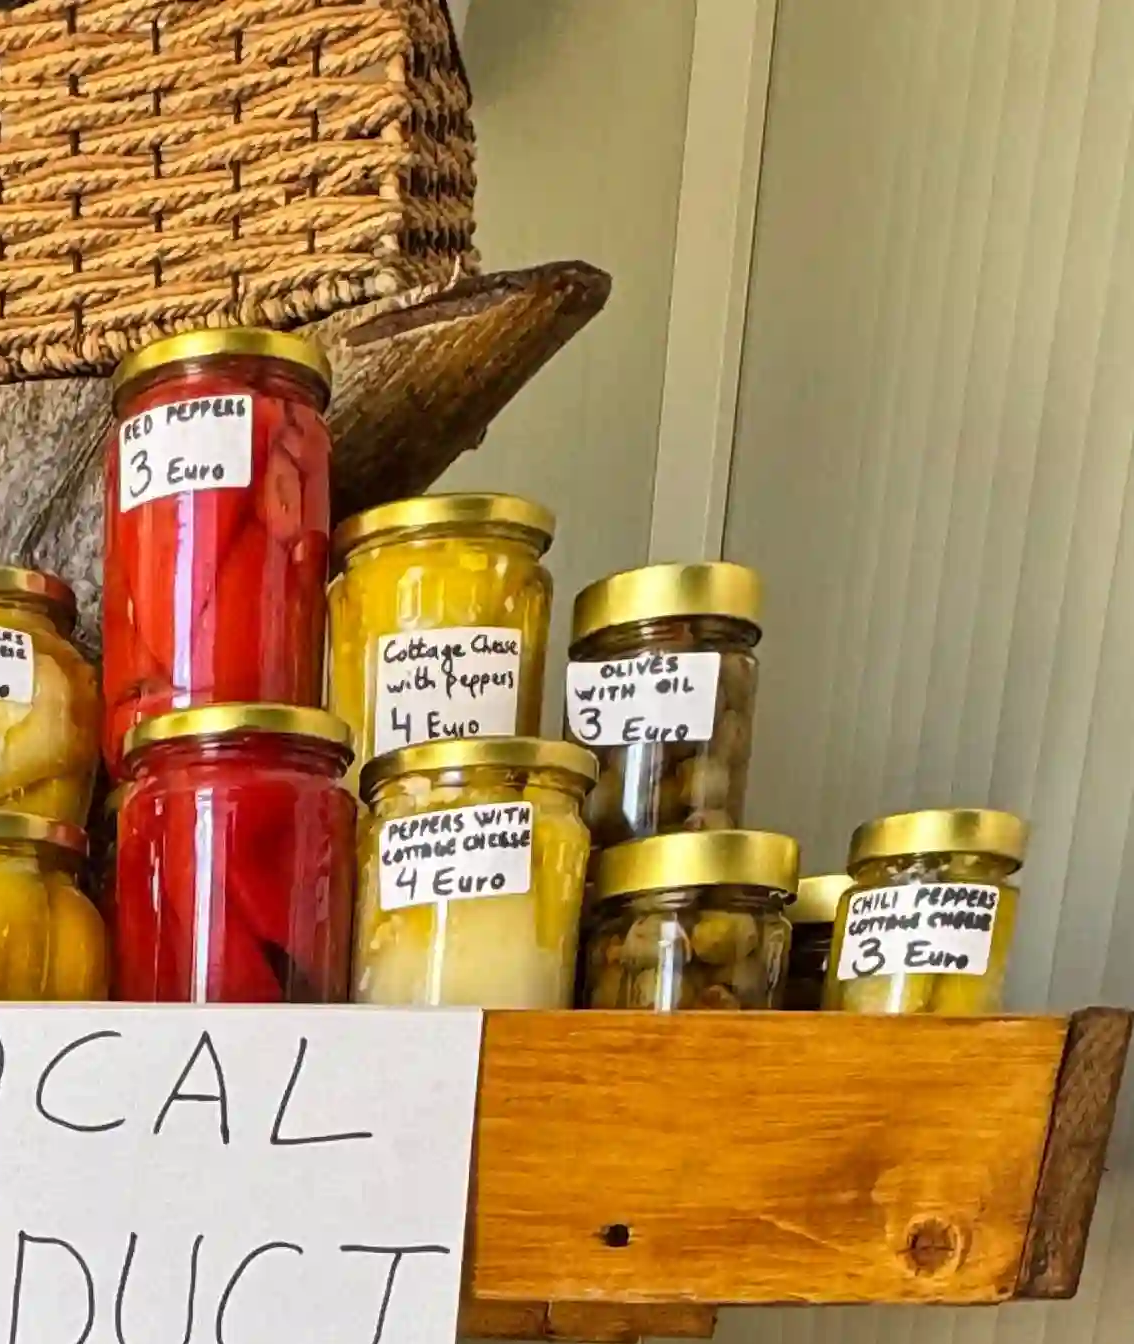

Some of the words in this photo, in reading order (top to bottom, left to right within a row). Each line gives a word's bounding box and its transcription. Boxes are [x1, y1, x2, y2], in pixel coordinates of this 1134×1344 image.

[124, 414, 153, 445] RED
[166, 398, 246, 425] PEPPERS
[129, 450, 152, 498] 3
[167, 456, 225, 484] Euro
[384, 637, 466, 674] Cottage
[600, 656, 678, 679] OLIVES
[387, 666, 436, 694] with
[446, 671, 514, 699] peppers
[575, 683, 636, 702] WITH
[655, 676, 694, 694] OIL
[391, 707, 411, 744] 4
[427, 711, 480, 739] Euro
[579, 708, 602, 741] 3
[622, 716, 689, 742] Euro
[388, 813, 465, 842] PEPPERS
[474, 807, 530, 827] WITH
[382, 838, 456, 866] COTTAGE
[463, 830, 531, 851] CHEESE
[396, 867, 417, 900] 4
[432, 867, 506, 895] Euro
[852, 891, 898, 915] CHILI
[914, 886, 999, 910] PEPPERS
[852, 937, 886, 976] 3
[904, 940, 969, 969] Euro
